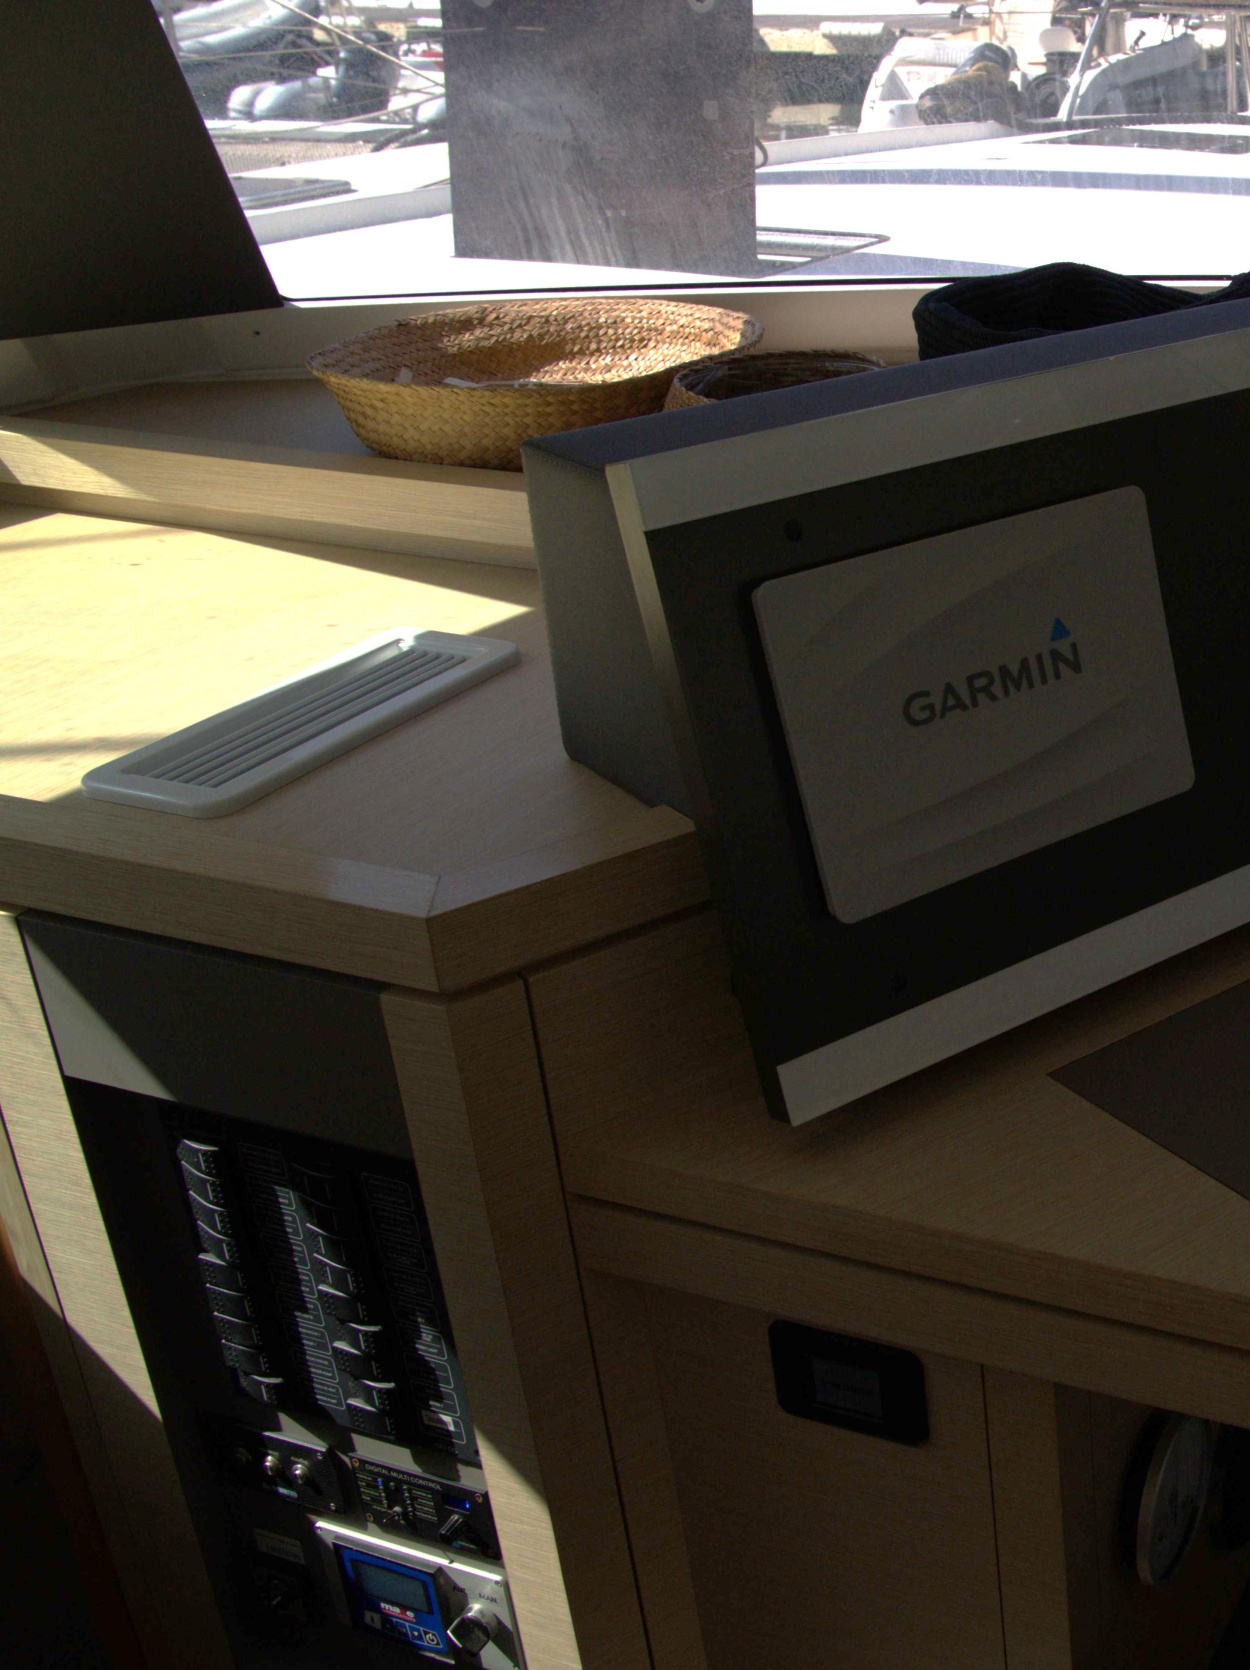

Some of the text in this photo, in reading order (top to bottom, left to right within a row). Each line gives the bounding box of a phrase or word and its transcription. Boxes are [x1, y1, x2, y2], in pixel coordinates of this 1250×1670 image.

[902, 643, 1082, 727] GARMIN
[365, 1465, 442, 1490] DIGITAL MULTI CONTROL
